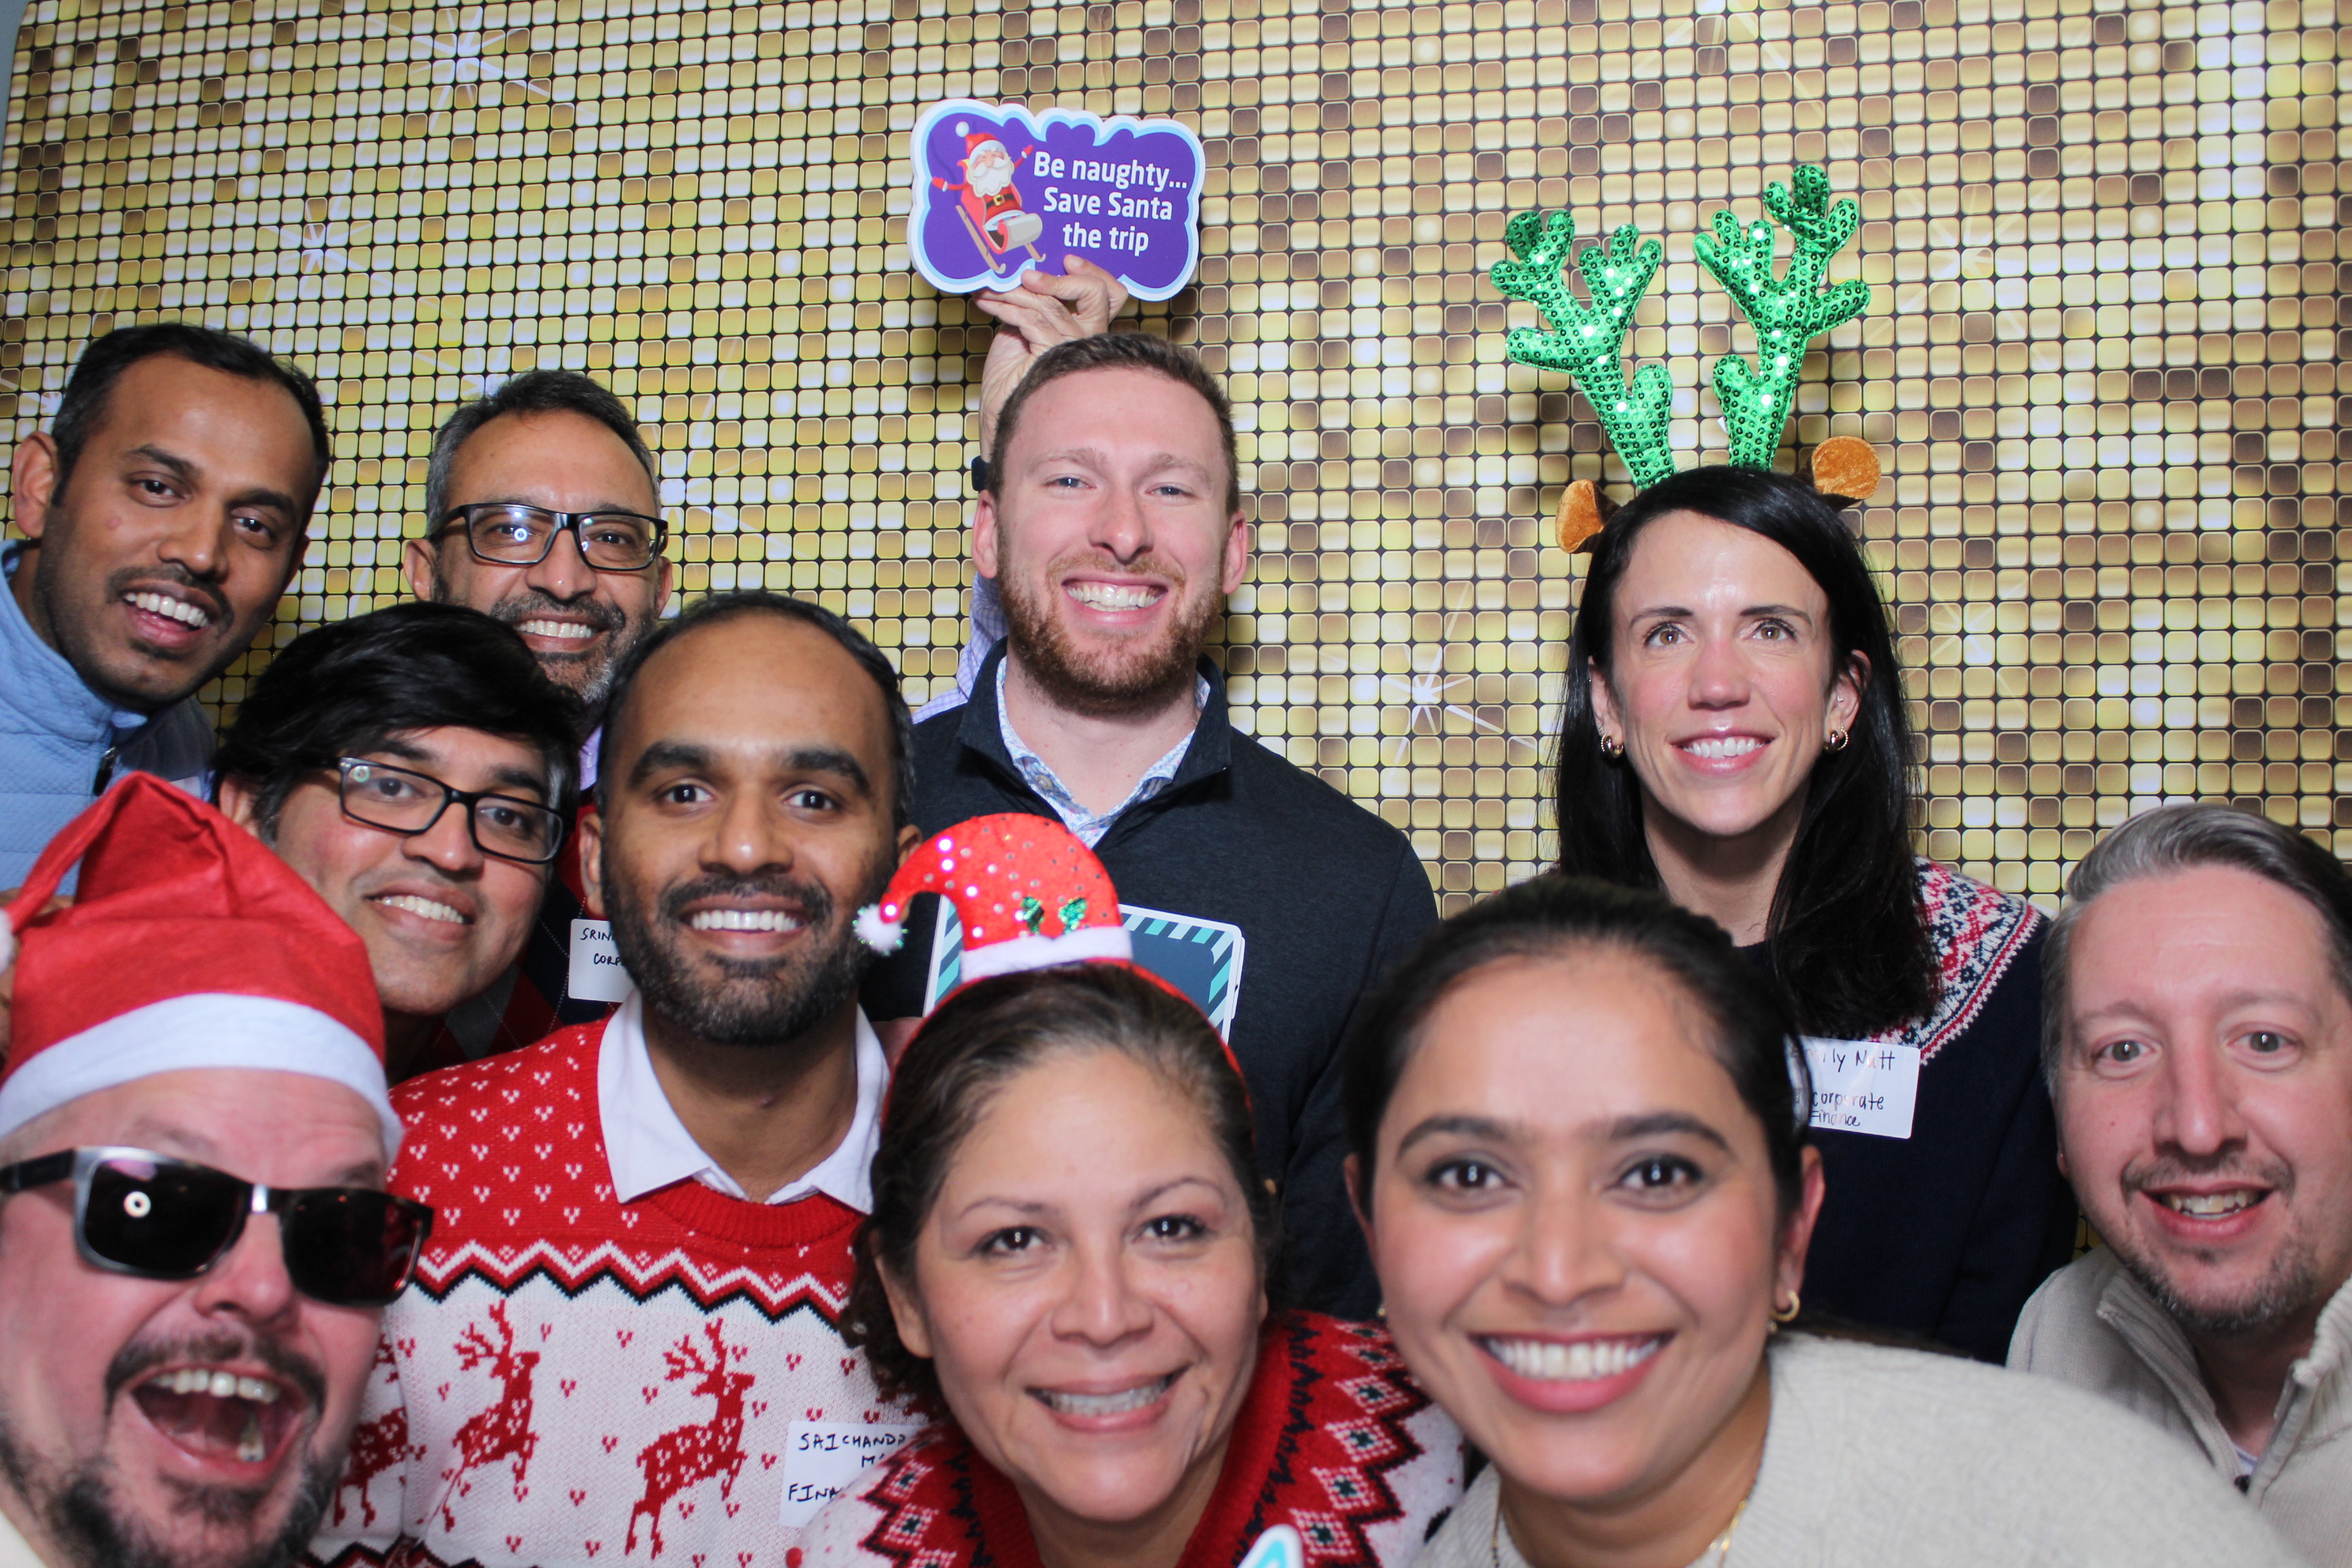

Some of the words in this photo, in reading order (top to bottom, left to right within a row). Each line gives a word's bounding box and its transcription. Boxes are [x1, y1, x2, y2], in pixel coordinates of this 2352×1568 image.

[1034, 151, 1065, 178] Be
[1072, 160, 1188, 192] naughty...
[1043, 187, 1100, 215] Save
[1108, 193, 1173, 220] Santa
[1062, 223, 1101, 248] the
[1109, 226, 1149, 256] trip
